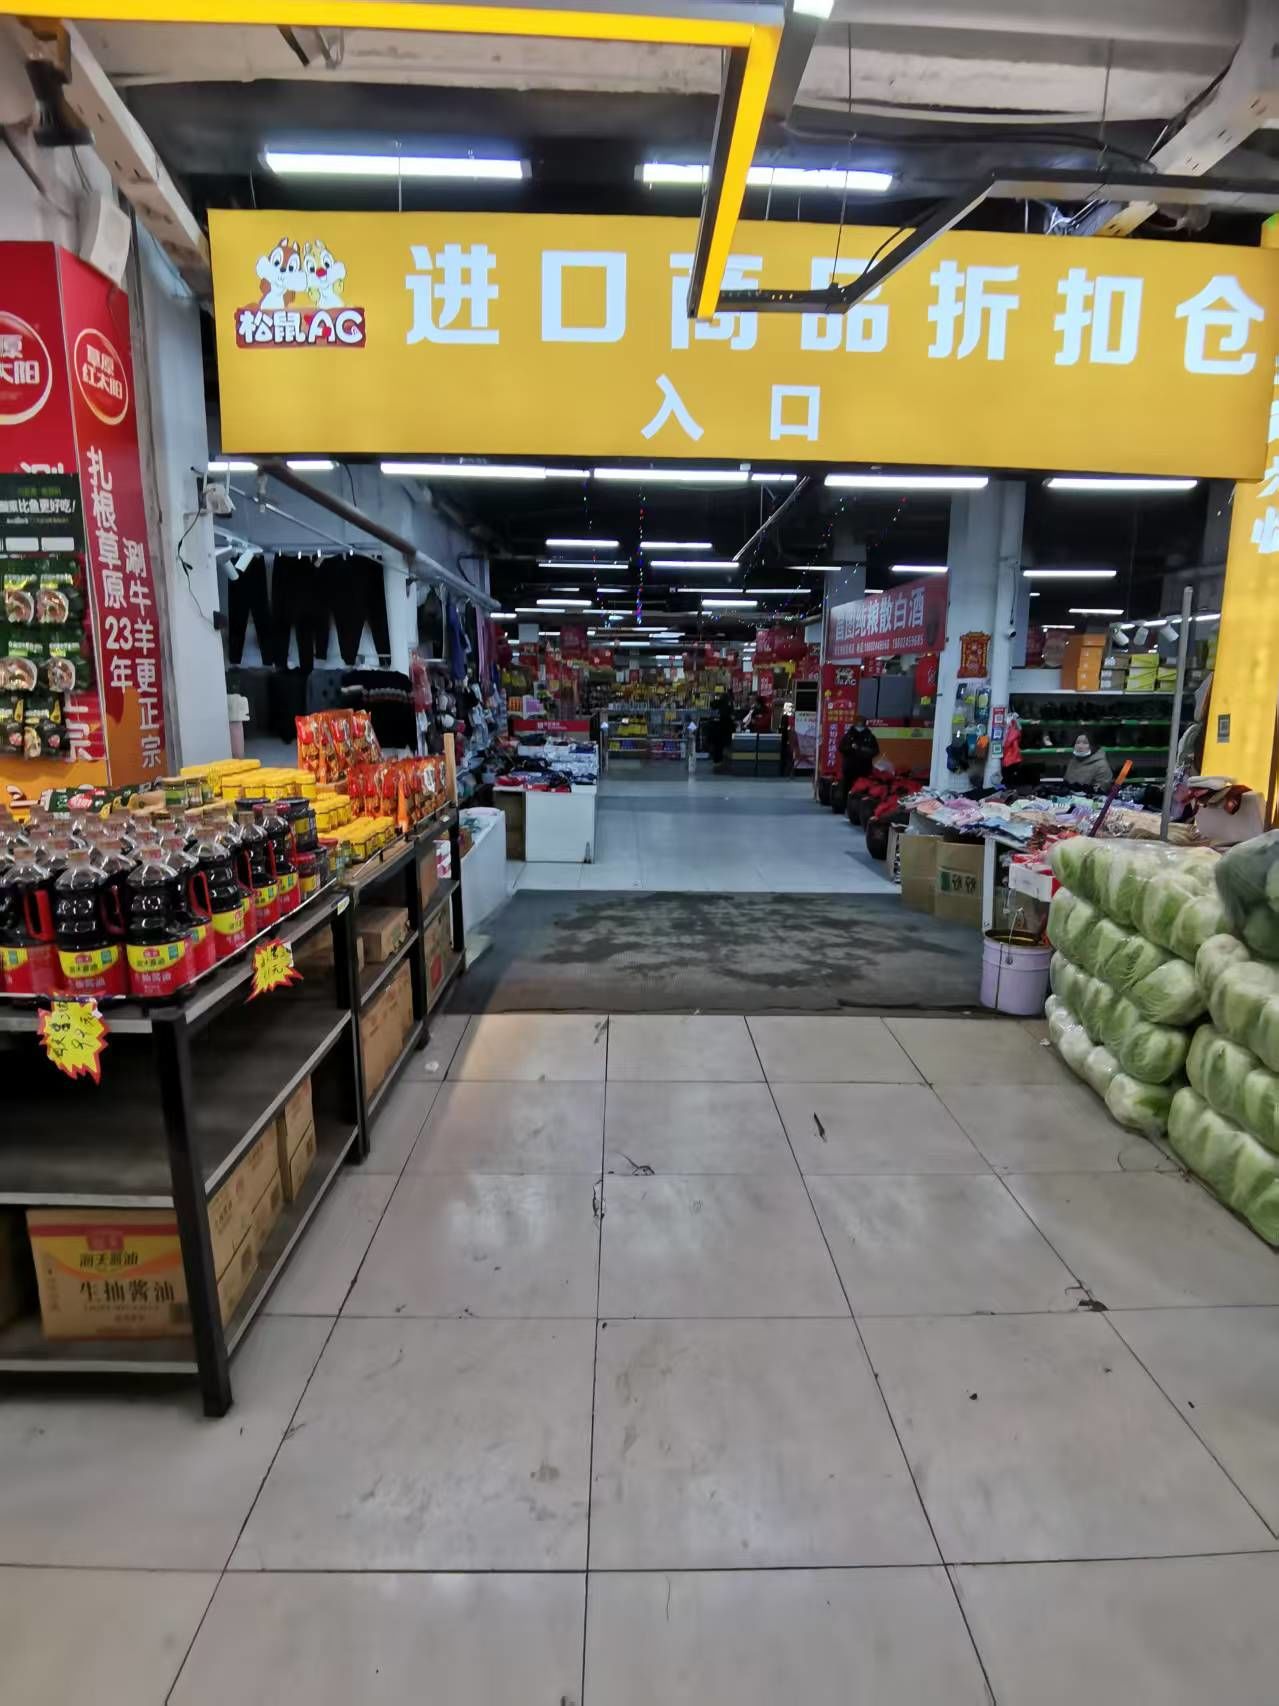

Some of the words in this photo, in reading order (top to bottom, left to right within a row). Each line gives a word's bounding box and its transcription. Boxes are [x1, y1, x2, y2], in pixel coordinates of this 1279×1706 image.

[405, 243, 1265, 375] 进口商品折扣仓
[81, 362, 123, 400] 红太阳
[640, 373, 820, 441] 入口
[80, 1279, 175, 1303] 生抽酱油
